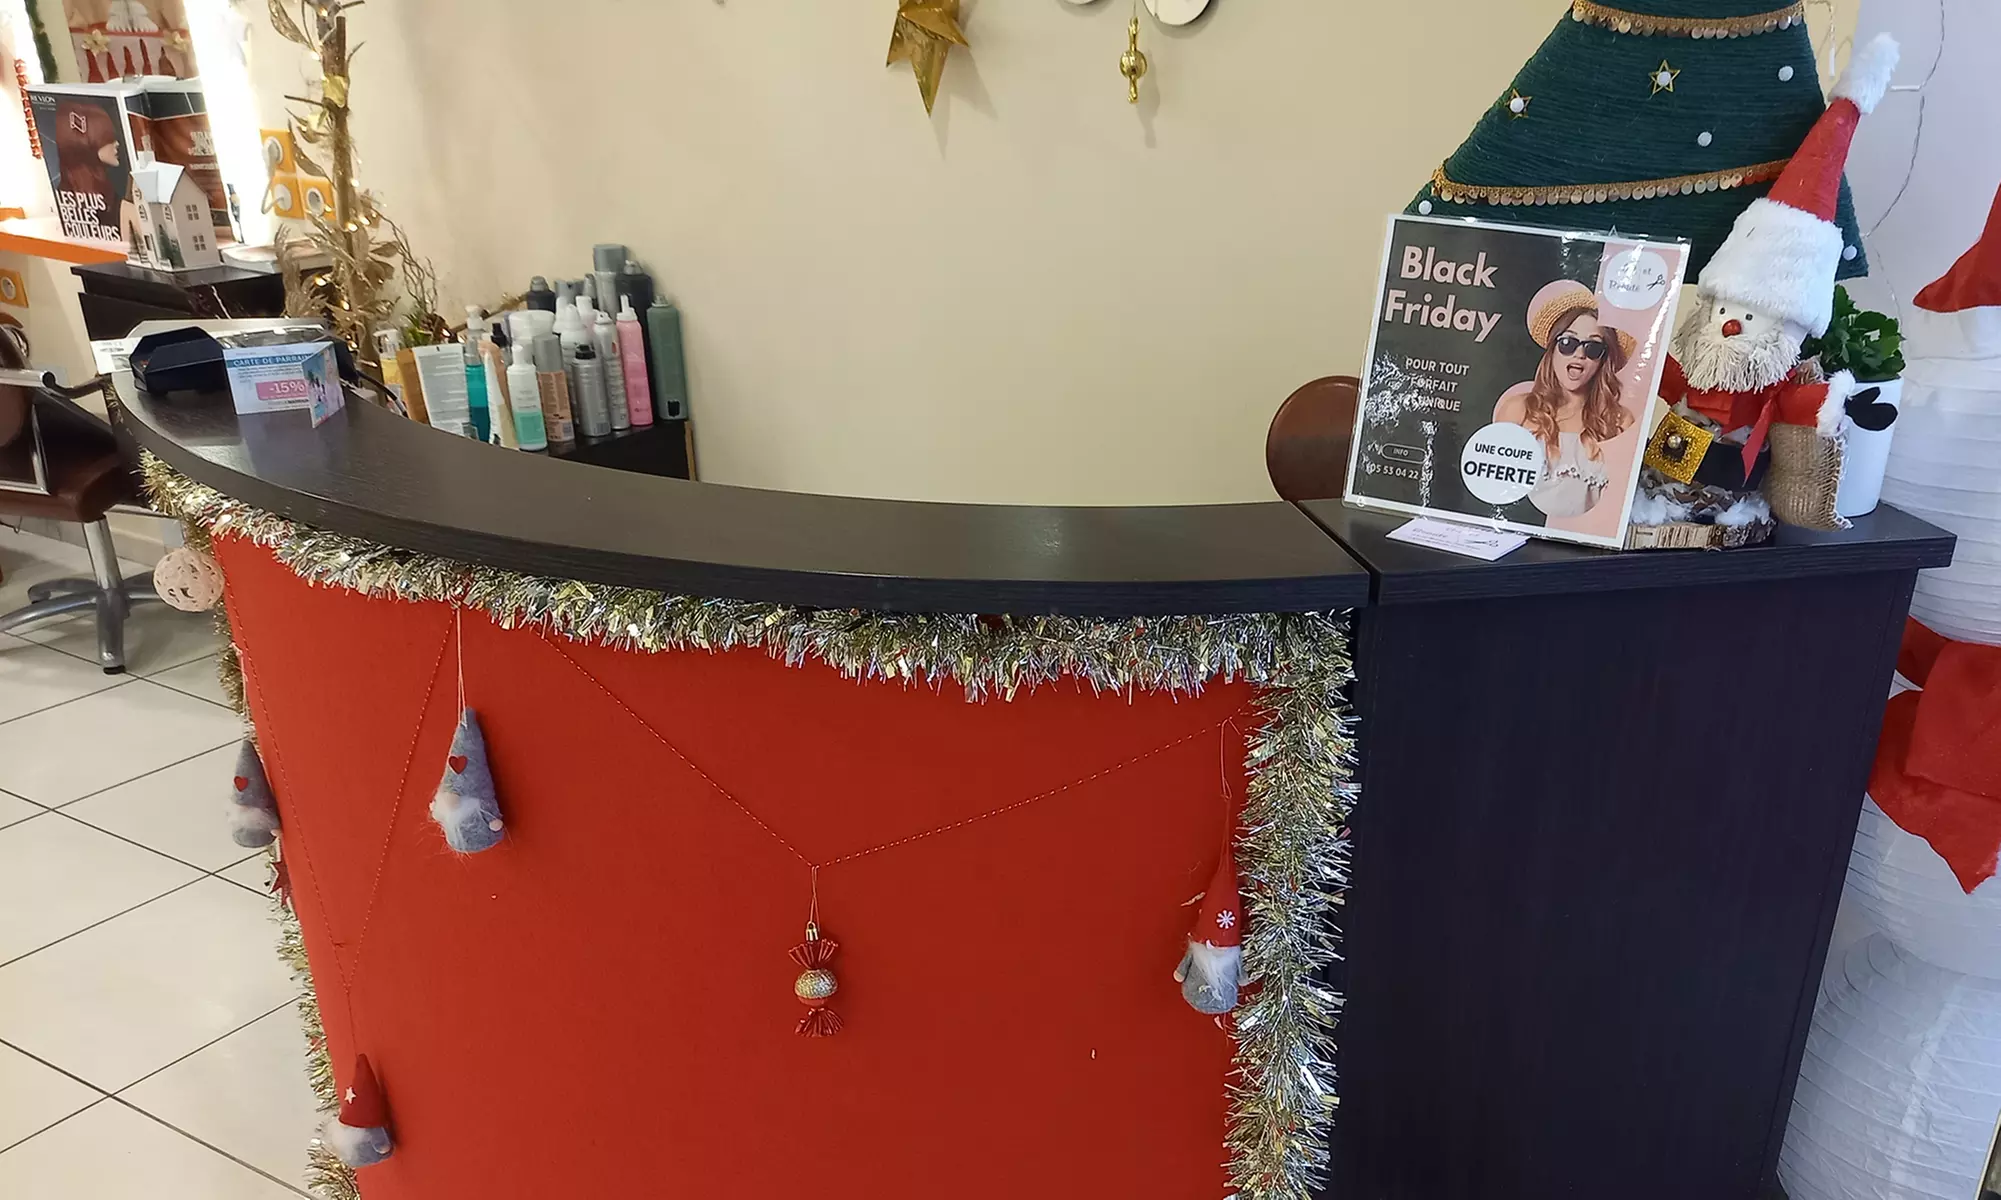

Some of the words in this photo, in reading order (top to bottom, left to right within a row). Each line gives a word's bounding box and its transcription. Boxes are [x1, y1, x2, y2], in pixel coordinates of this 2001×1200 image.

[55, 189, 77, 207] LES
[75, 191, 106, 211] PLUS
[61, 206, 99, 225] BELLES
[64, 222, 121, 241] COULEURS
[1400, 245, 1498, 288] Black
[1385, 289, 1502, 342] Friday
[233, 358, 261, 366] CARTE
[1405, 358, 1436, 372] POUR
[1439, 362, 1470, 376] TOUT
[269, 380, 305, 394] -15%
[1410, 376, 1458, 393] FORFAIT
[1474, 442, 1496, 455] UNE
[1497, 446, 1533, 460] COUPE
[1463, 460, 1537, 485] OFFERTE
